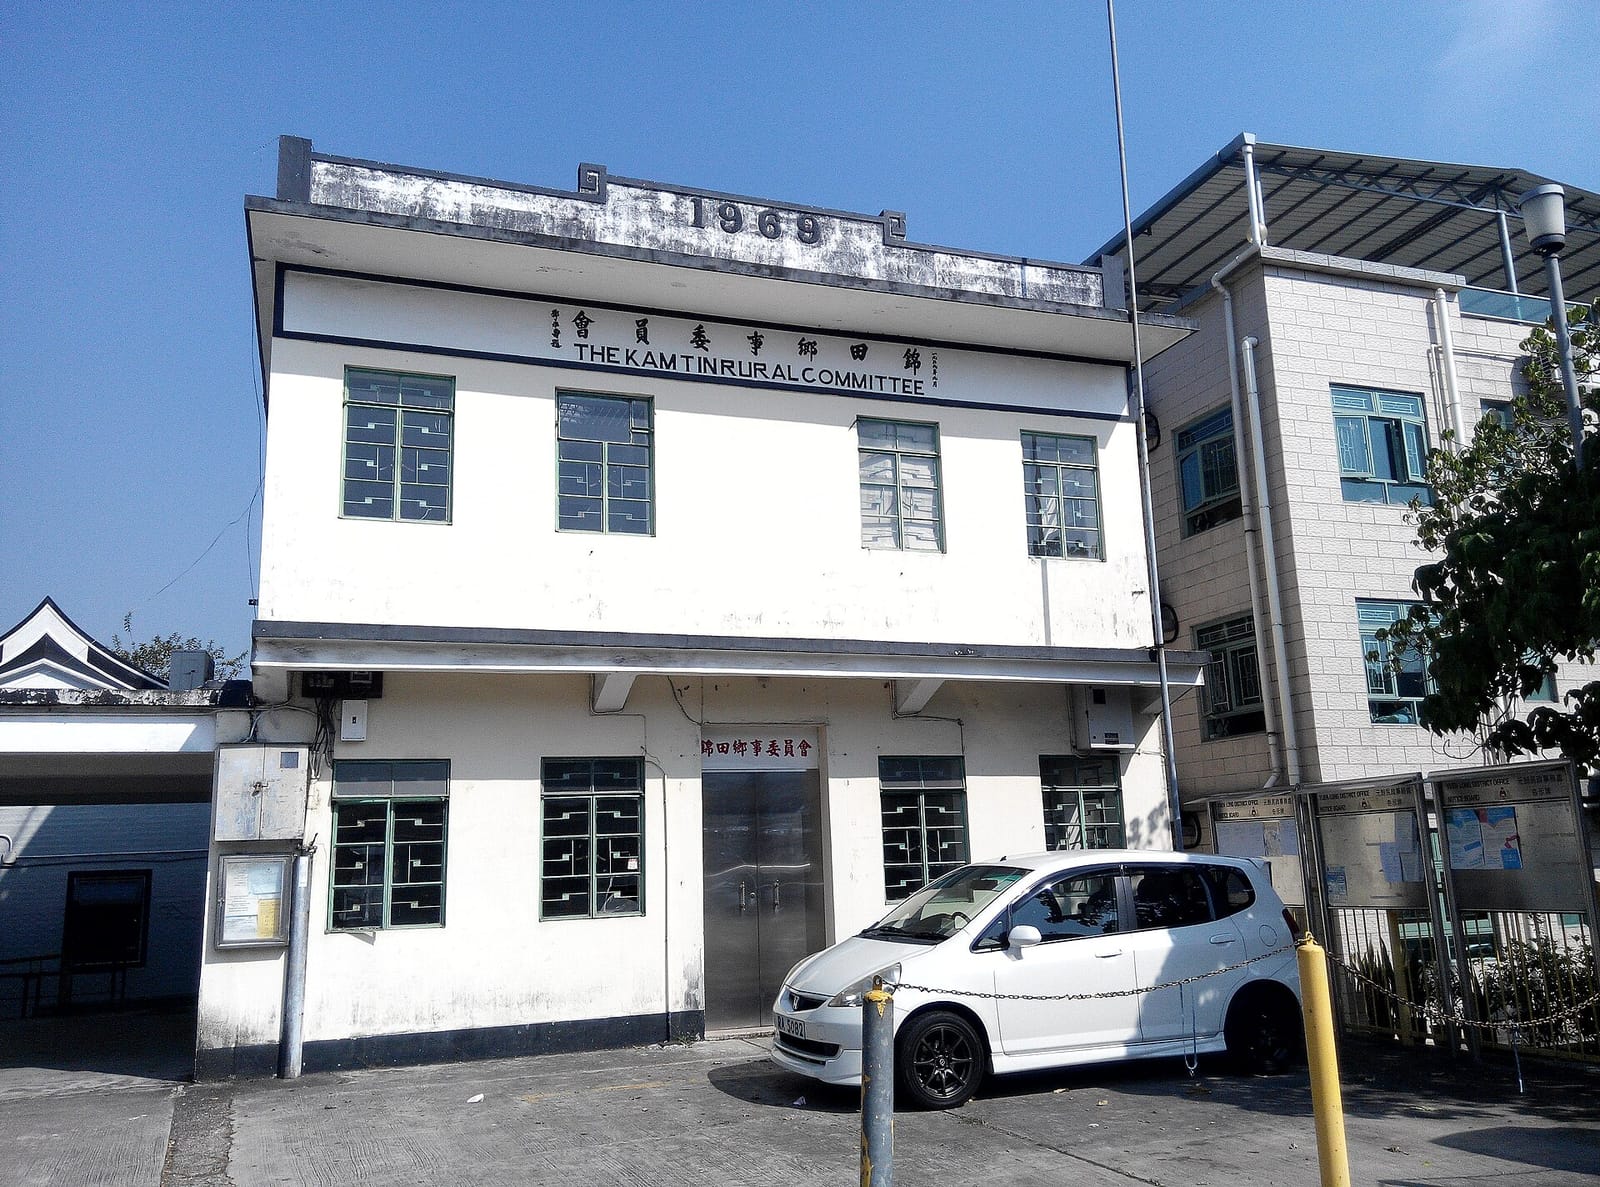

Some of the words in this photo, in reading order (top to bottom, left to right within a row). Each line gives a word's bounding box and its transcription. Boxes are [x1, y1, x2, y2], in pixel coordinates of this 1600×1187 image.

[689, 199, 822, 244] 1969
[573, 343, 620, 364] THE
[625, 349, 677, 371] KAM
[720, 359, 799, 382] RURAL
[801, 367, 925, 396] COMMITTEE
